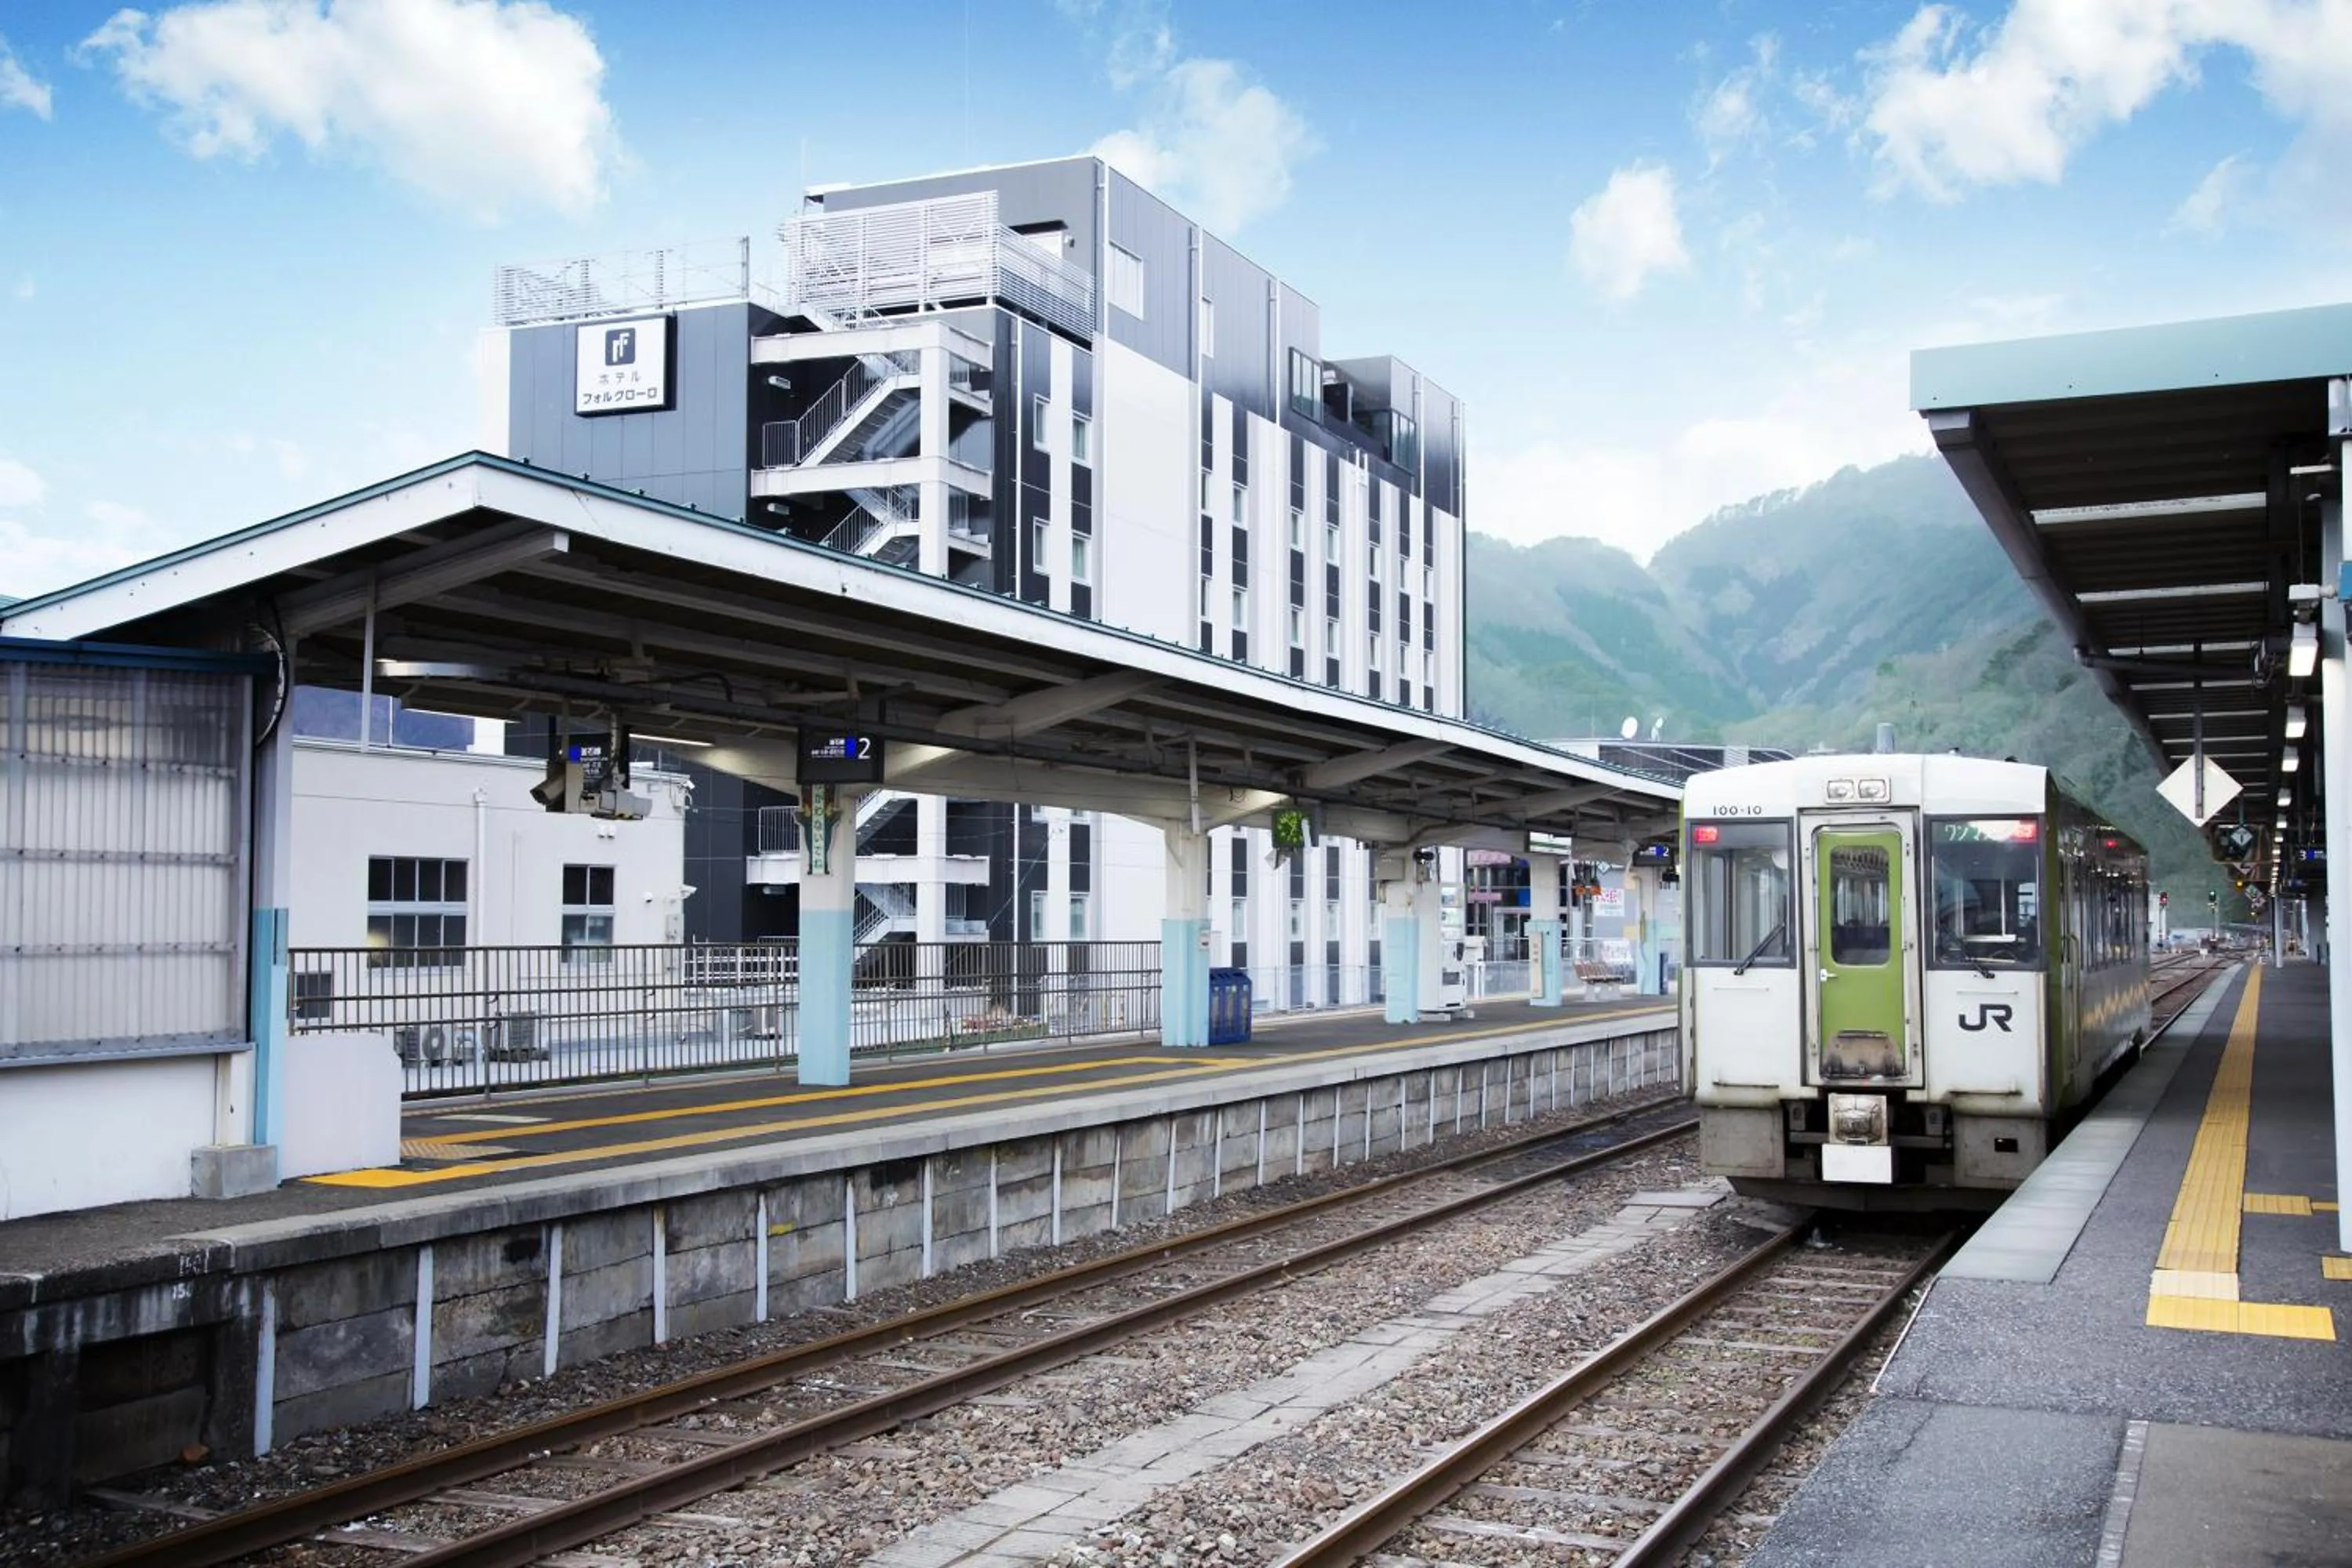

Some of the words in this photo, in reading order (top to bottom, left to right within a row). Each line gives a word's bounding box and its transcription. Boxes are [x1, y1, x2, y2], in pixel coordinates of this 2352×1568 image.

[599, 370, 641, 384] ホテル
[583, 387, 658, 405] フォルクローロ
[858, 737, 871, 760] 2
[1713, 805, 1762, 816] 100-10
[2299, 849, 2307, 860] 3
[1958, 1004, 2013, 1033] JR
